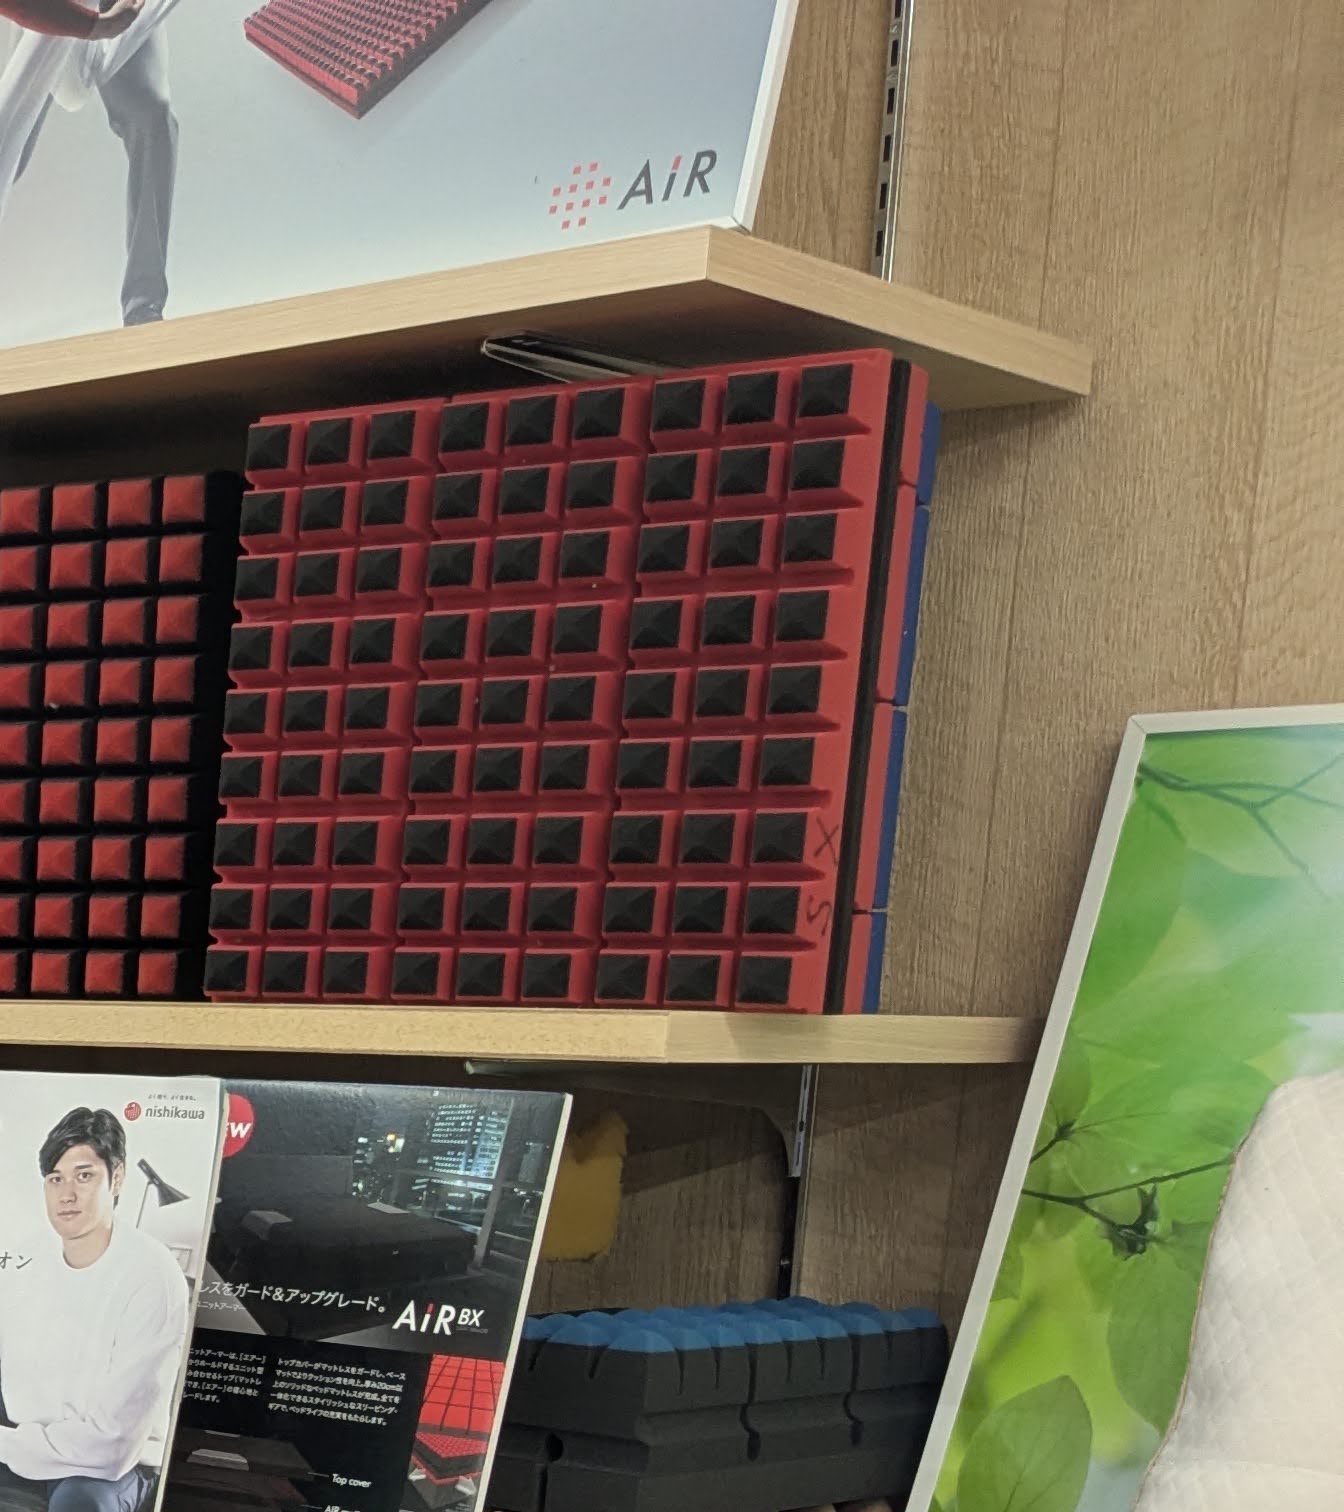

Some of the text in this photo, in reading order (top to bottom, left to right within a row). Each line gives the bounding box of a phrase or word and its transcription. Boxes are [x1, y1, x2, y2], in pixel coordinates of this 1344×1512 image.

[145, 1105, 205, 1120] nishikawa
[457, 1308, 484, 1328] BX
[332, 1473, 372, 1489] Top cover
